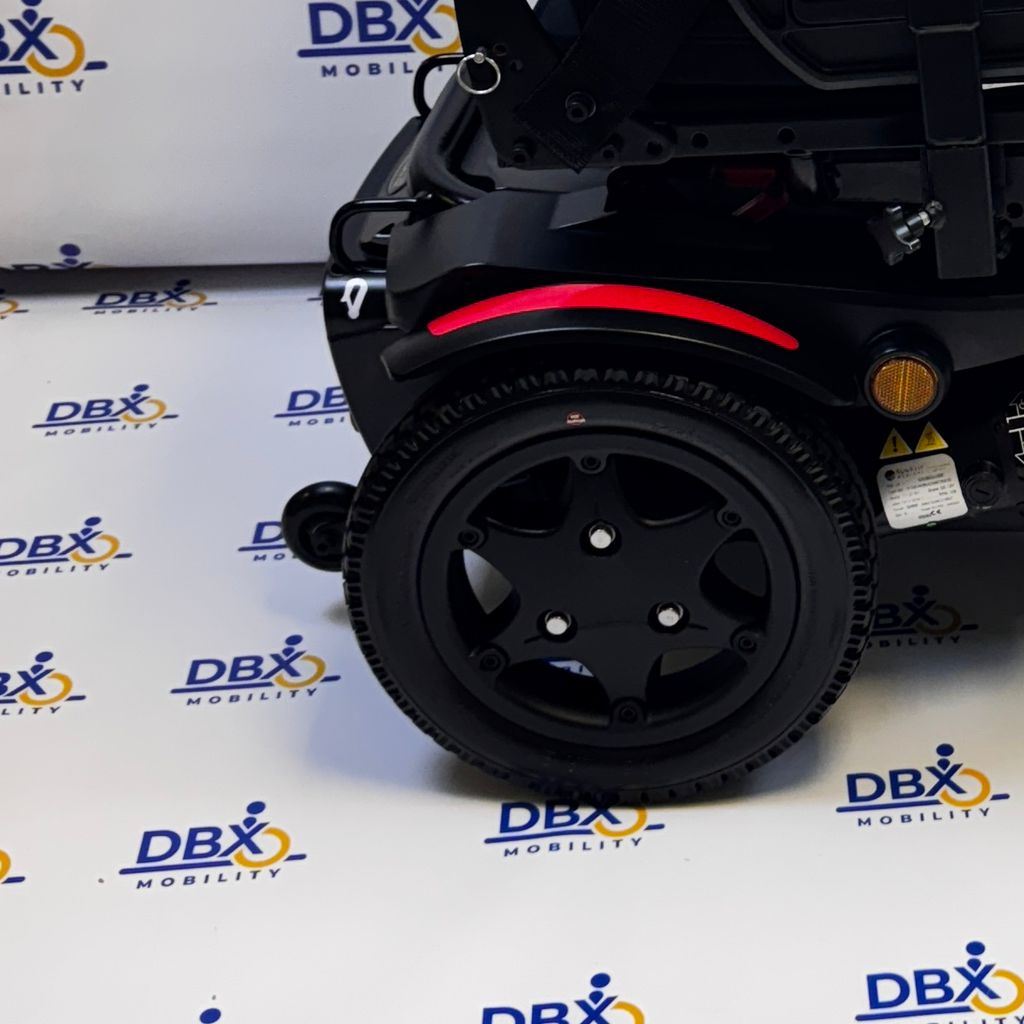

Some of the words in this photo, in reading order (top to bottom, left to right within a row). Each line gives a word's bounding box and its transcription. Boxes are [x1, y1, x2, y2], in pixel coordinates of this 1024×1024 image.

[321, 61, 440, 77] MOBIL
[4, 79, 85, 95] ILITY
[95, 289, 191, 306] DBX
[287, 386, 349, 411] DB
[46, 396, 150, 422] DBX
[46, 424, 156, 436] MOBILITY
[288, 416, 345, 426] MOBI
[0, 531, 103, 559] DBX
[7, 564, 109, 576] OBILITY
[872, 600, 939, 628] BX
[186, 650, 307, 685] DBX
[187, 688, 317, 705] MOBILITY
[847, 764, 966, 803] DBX
[858, 808, 989, 826] MOBILITY
[136, 822, 269, 864] DBX
[504, 838, 641, 856] MOBILITY
[137, 869, 280, 889] MOBILITY
[867, 964, 1000, 1009] DBX
